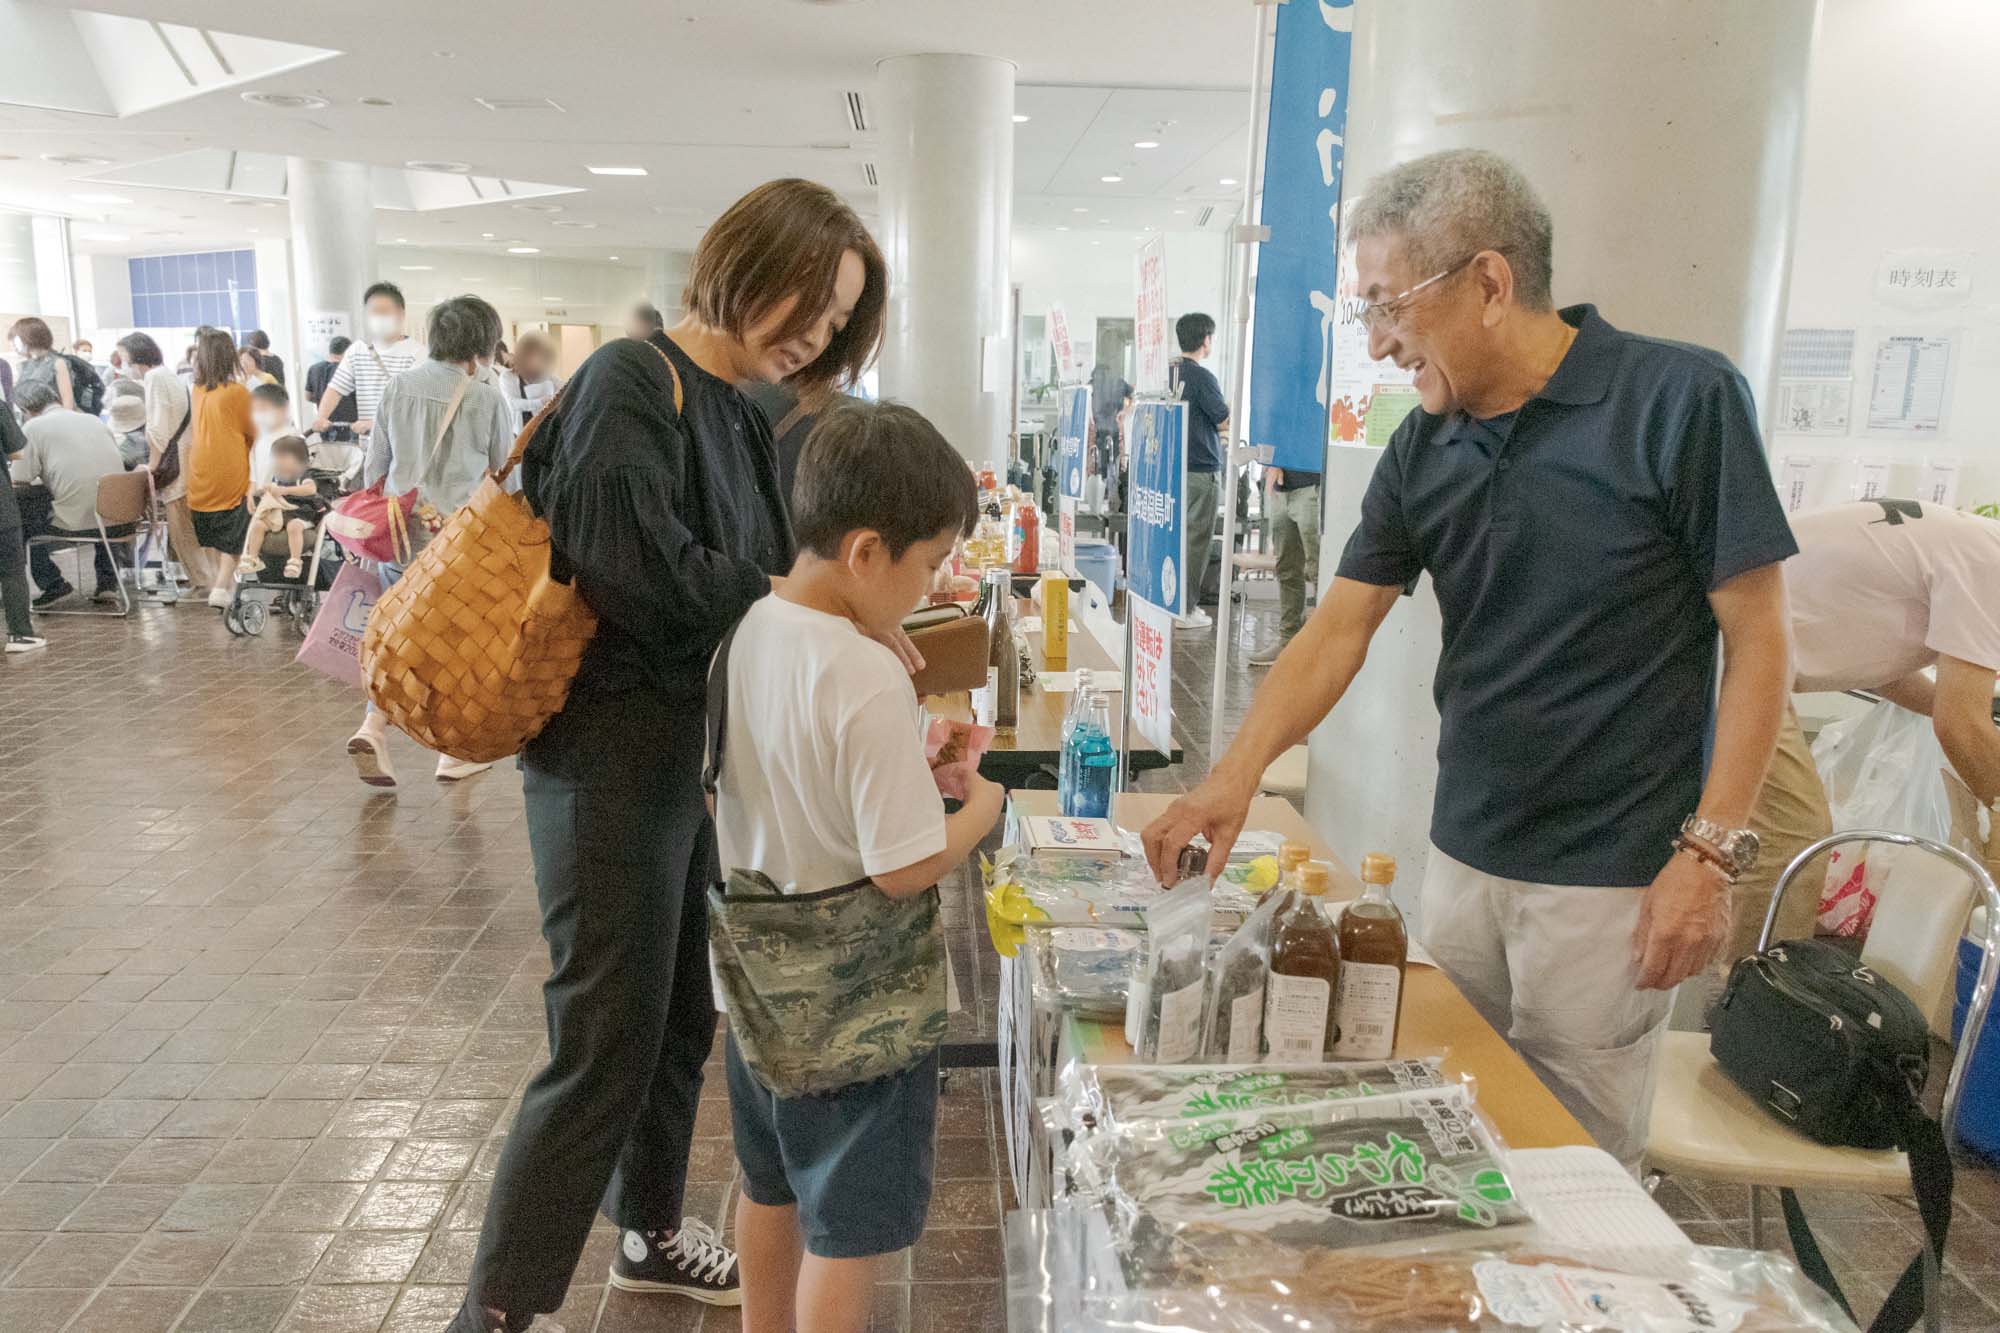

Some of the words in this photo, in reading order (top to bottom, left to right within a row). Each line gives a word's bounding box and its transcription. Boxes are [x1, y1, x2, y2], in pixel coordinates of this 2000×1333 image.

[1890, 267, 1957, 289] 時刻表
[1205, 1132, 1425, 1207] やわらか昆布
